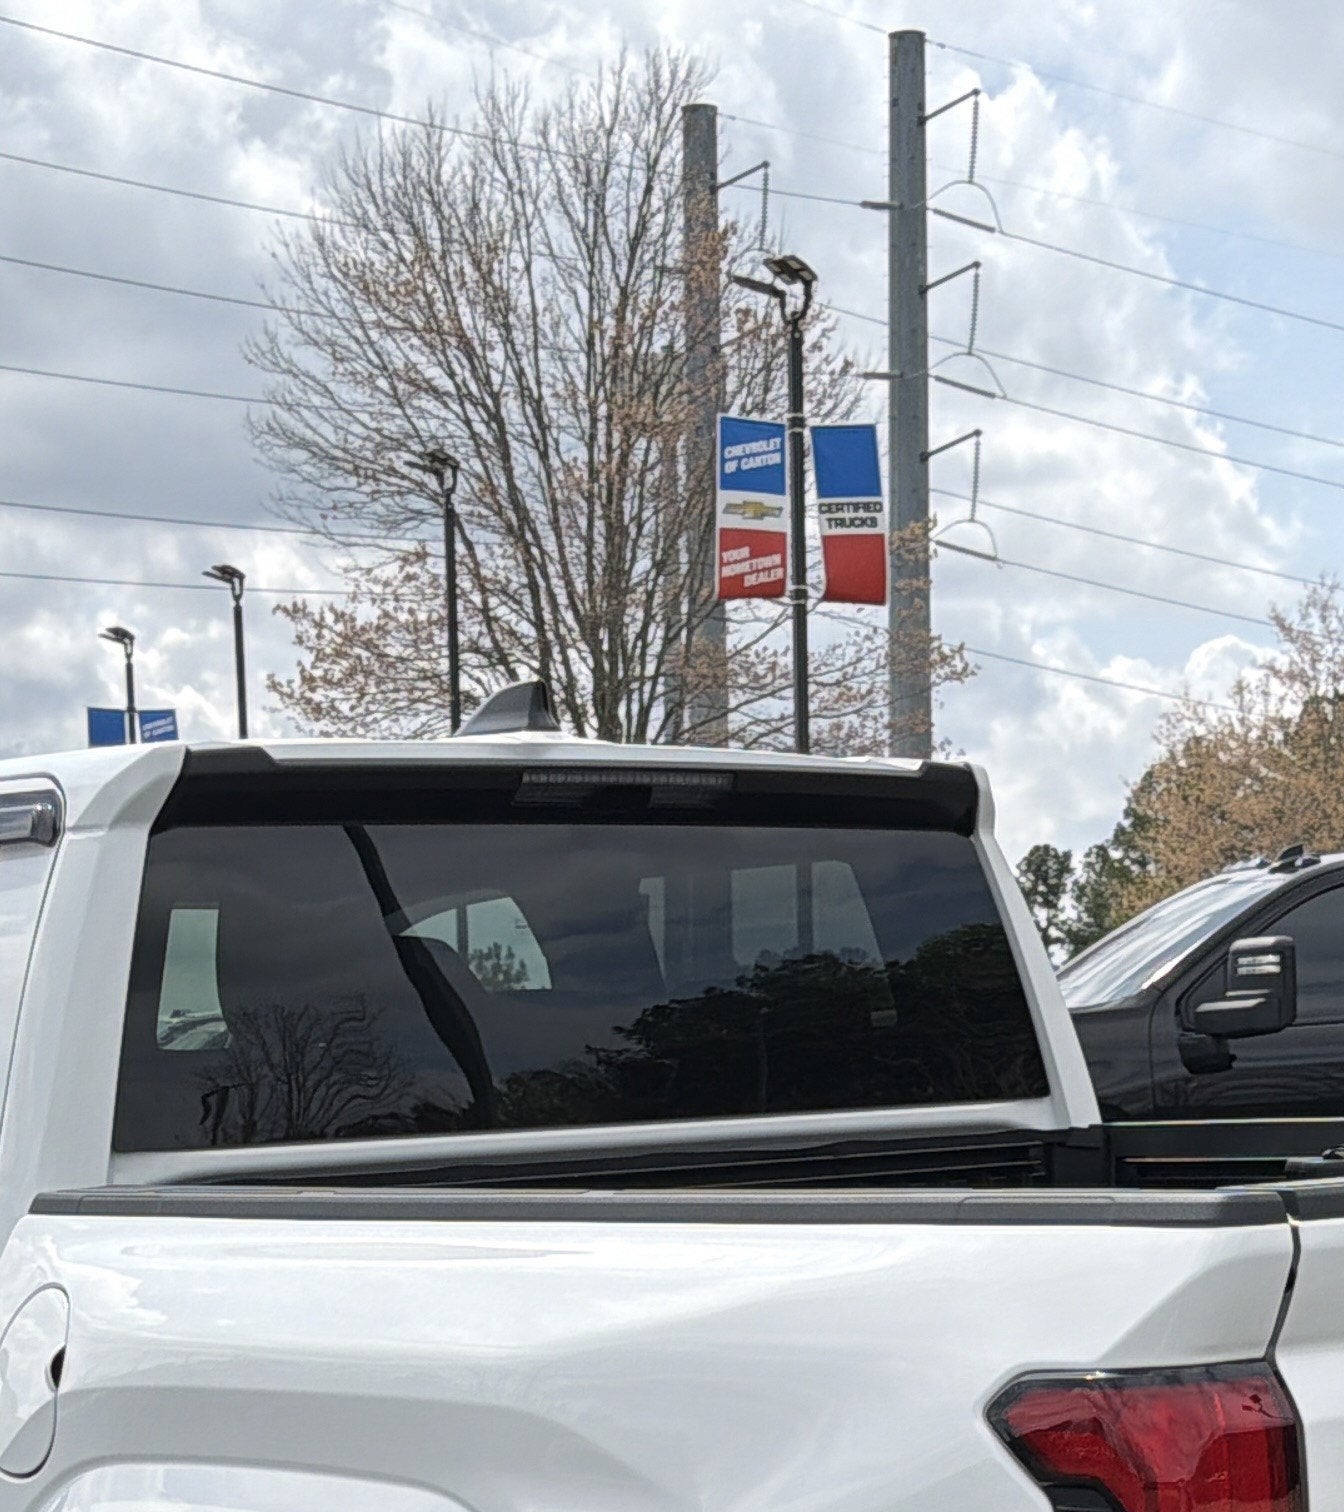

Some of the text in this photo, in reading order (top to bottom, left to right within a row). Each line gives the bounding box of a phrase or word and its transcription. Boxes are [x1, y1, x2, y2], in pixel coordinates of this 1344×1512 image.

[724, 438, 781, 459] CHEVROLET
[724, 452, 781, 474] OF CANTON
[818, 501, 883, 515] CERTIFIED
[827, 516, 878, 529] TRUCKS
[743, 567, 784, 588] DEALER
